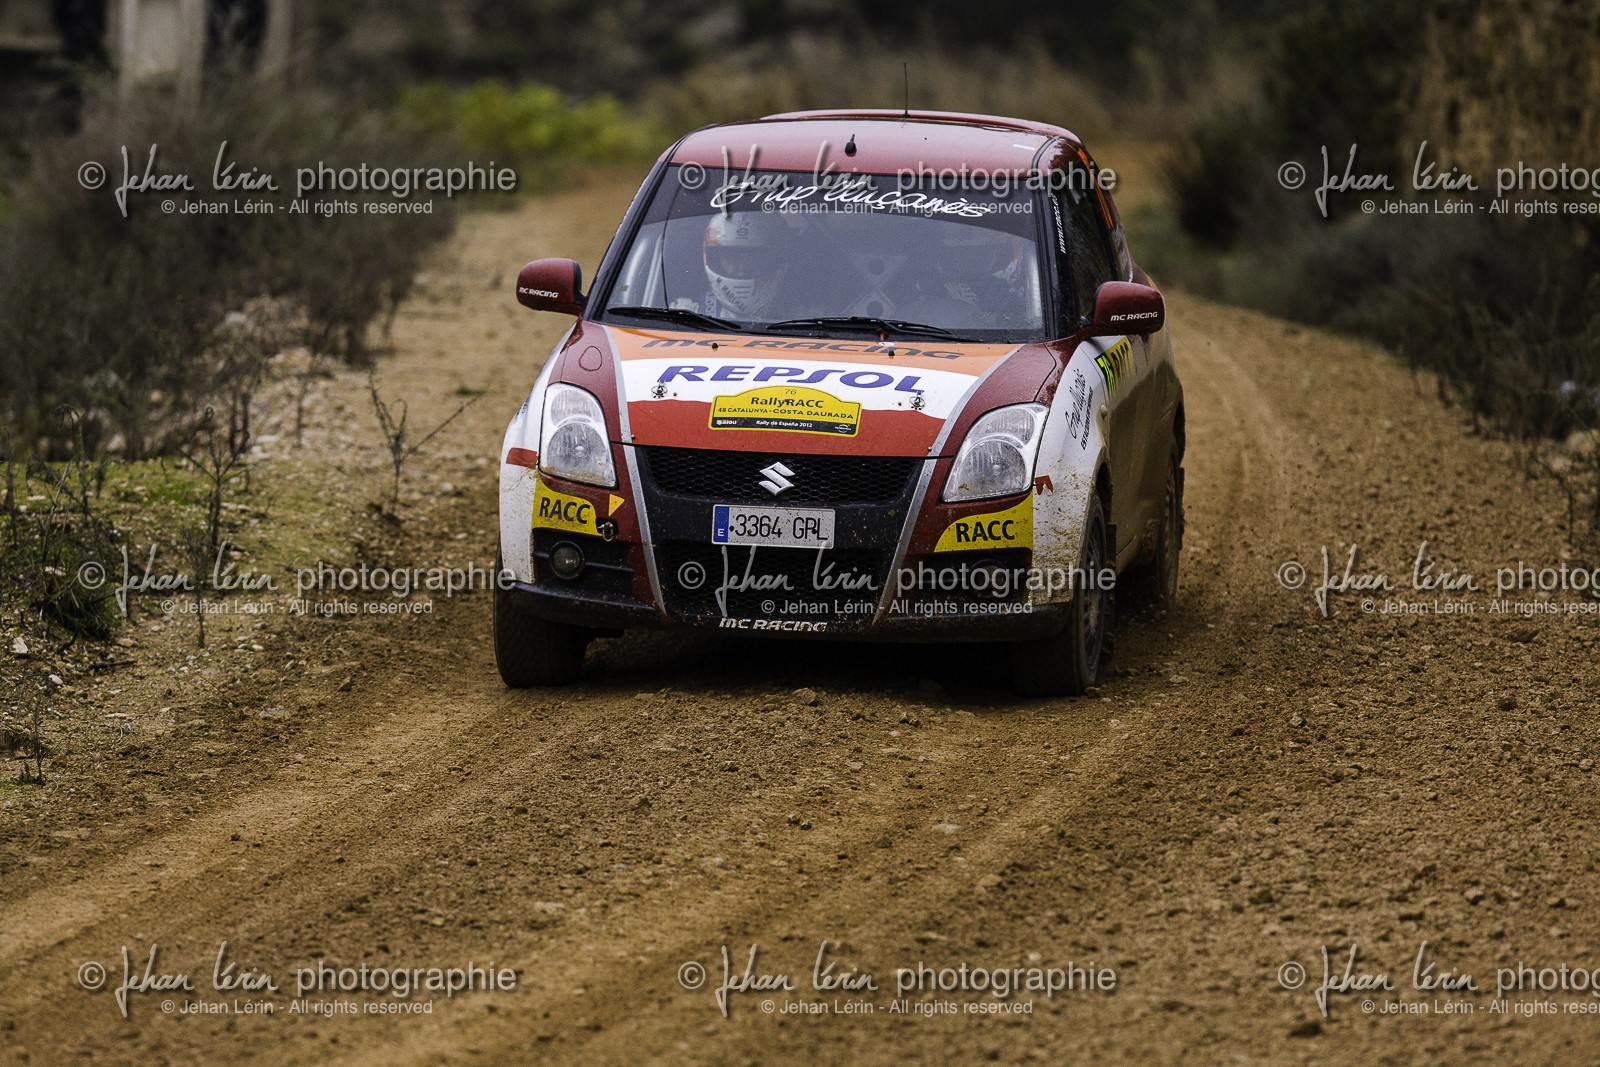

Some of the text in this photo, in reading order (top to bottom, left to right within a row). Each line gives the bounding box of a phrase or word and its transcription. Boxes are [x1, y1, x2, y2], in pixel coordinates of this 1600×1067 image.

[529, 288, 559, 298] RACING
[1127, 311, 1158, 320] RACING
[642, 339, 965, 360] MC RACING
[656, 365, 925, 394] REPSOL
[750, 397, 825, 409] RallyRACC
[807, 410, 854, 419] DAURADA
[539, 496, 590, 524] RACC
[735, 513, 782, 538] 3364
[955, 519, 1015, 542] RACC
[717, 528, 724, 537] E
[753, 619, 828, 632] RACING
